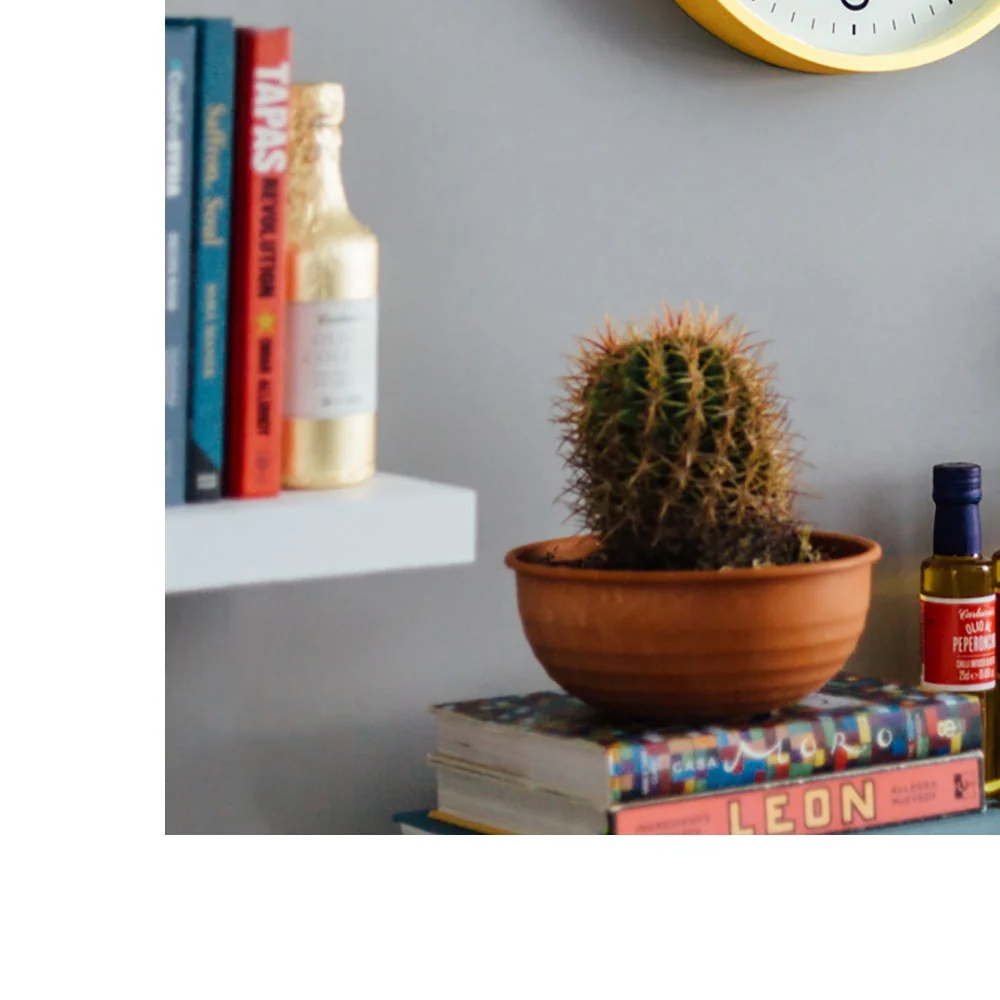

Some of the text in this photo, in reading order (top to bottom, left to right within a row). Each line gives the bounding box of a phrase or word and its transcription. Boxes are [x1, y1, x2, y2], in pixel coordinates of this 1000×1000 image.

[253, 61, 291, 298] TAPAS REVOLUTION
[728, 779, 876, 835] LEON
